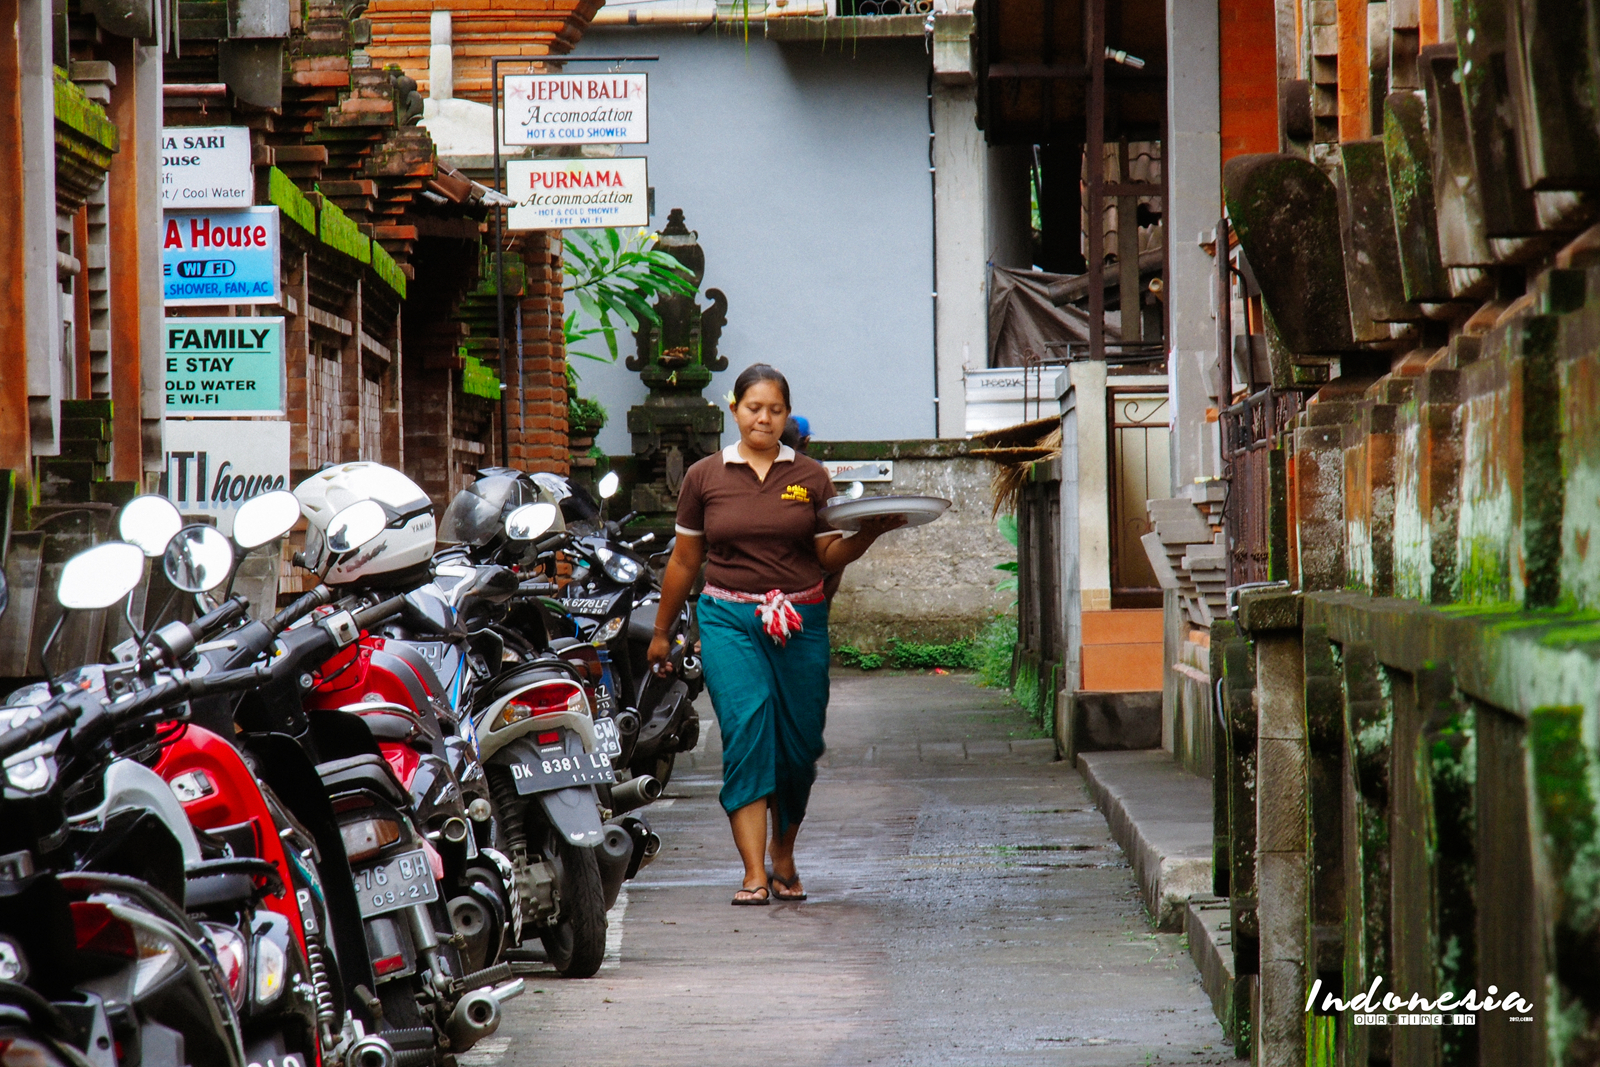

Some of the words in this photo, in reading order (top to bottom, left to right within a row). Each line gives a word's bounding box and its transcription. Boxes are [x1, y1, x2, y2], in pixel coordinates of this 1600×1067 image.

[527, 80, 583, 101] JEPUN
[588, 80, 628, 99] BALI
[521, 106, 633, 126] Accomodation
[526, 128, 546, 139] HOT
[550, 129, 556, 138] &
[558, 128, 584, 138] COLD
[587, 128, 627, 138] SHOWER
[183, 136, 225, 149] SARI
[530, 170, 623, 189] PURNAMA
[183, 188, 208, 198] Cool
[213, 188, 245, 198] Water
[520, 190, 633, 207] Accommodation
[564, 208, 585, 216] COLD
[588, 206, 619, 215] SHOWER
[190, 218, 267, 248] House
[170, 282, 222, 296] SHOWER,
[224, 282, 250, 294] FAN,
[253, 282, 268, 293] AC
[168, 329, 270, 349] FAMILY
[186, 358, 234, 372] STAY
[201, 380, 256, 390] WATER
[180, 394, 219, 404] WI-FI
[593, 721, 615, 740] CW
[511, 763, 534, 780] DK
[542, 756, 580, 774] 8381
[589, 752, 610, 768] LB
[398, 856, 428, 880] BH
